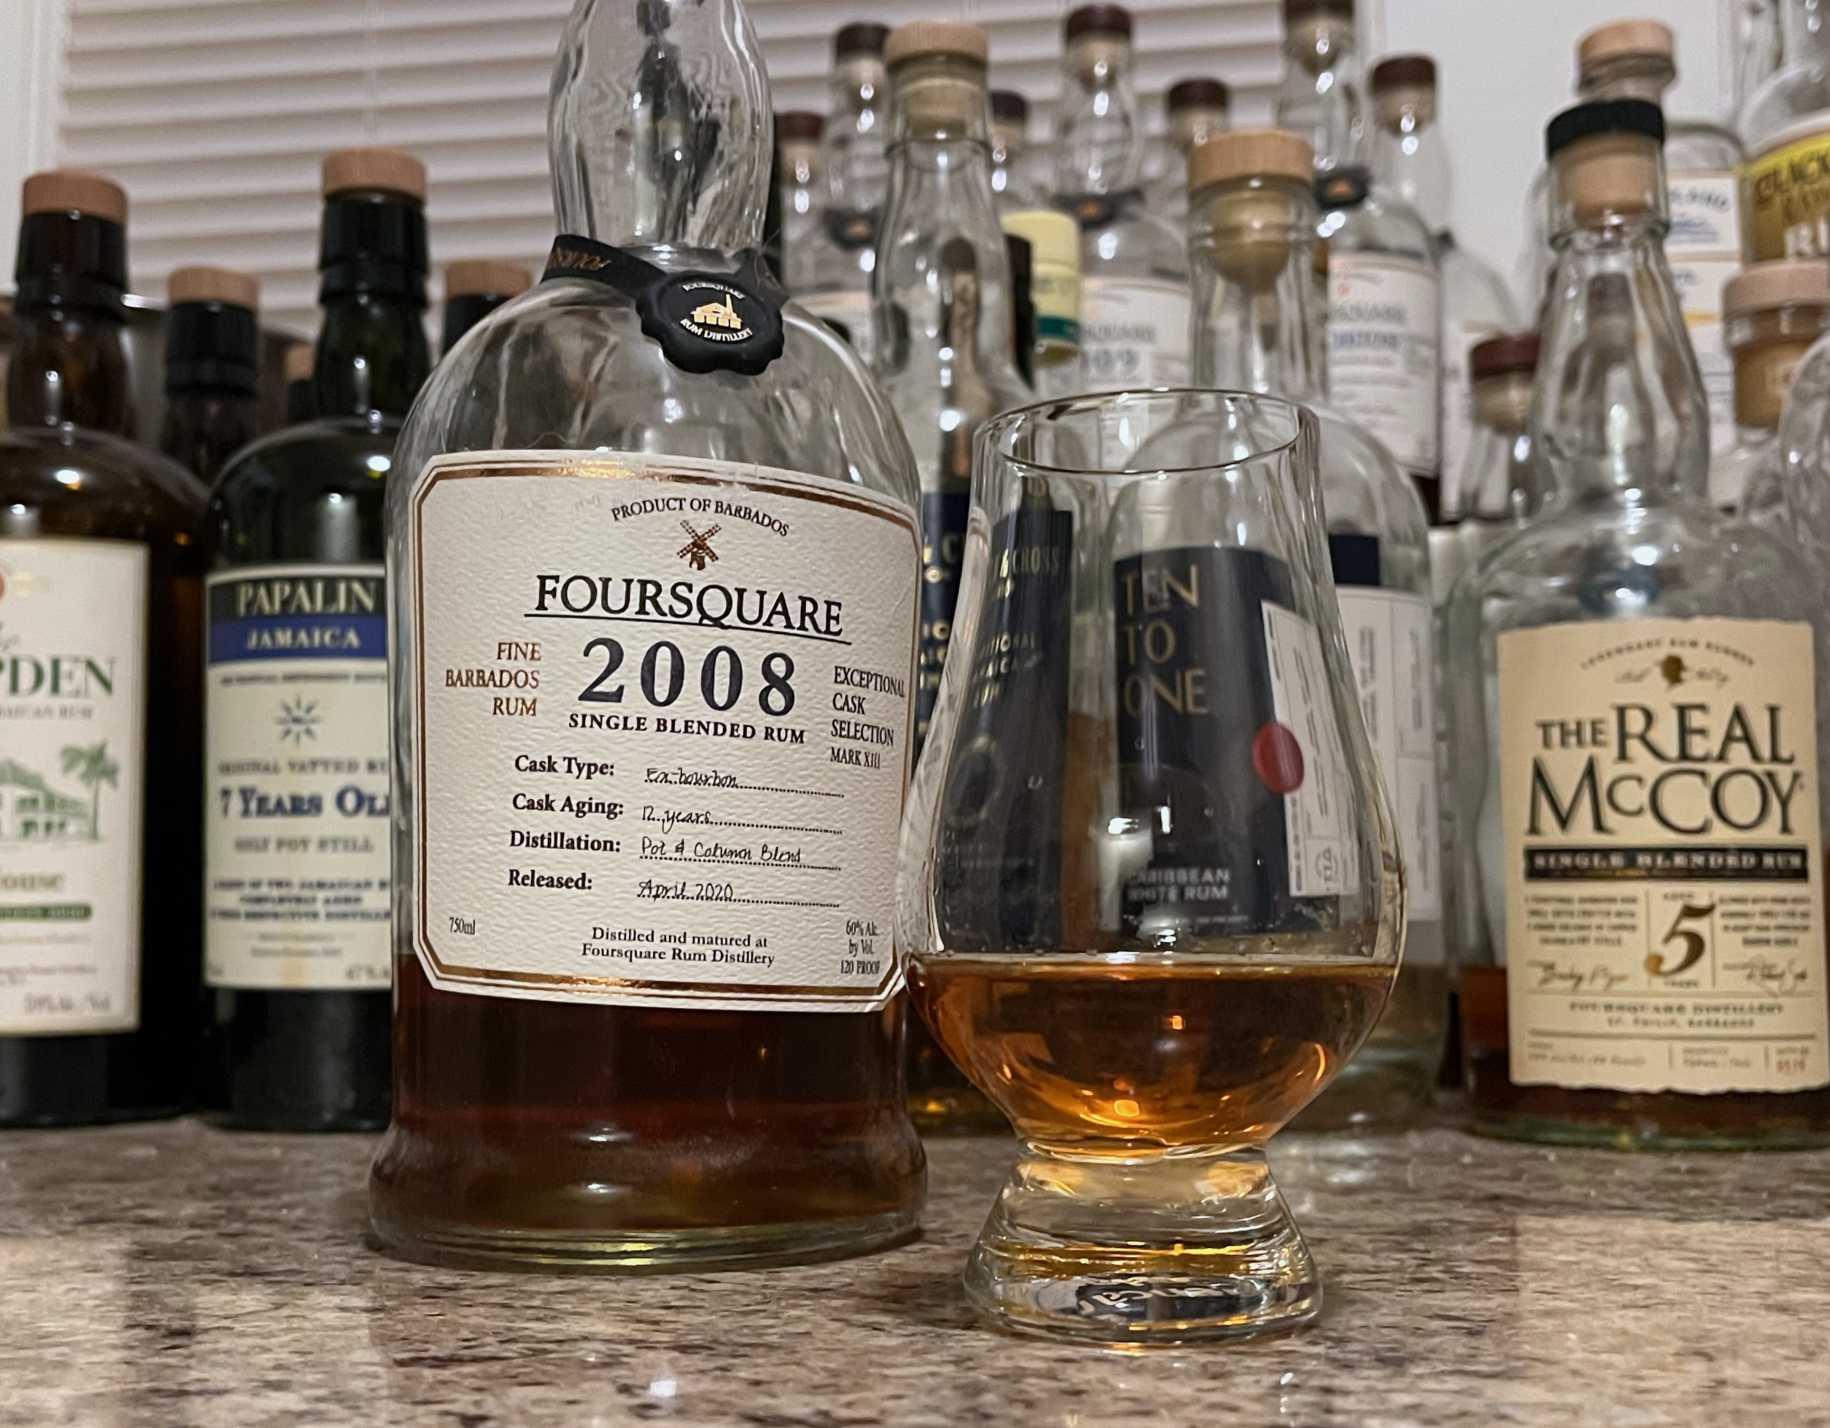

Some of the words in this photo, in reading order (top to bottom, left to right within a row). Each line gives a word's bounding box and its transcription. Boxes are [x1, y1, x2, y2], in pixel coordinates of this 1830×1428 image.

[680, 318, 703, 336] RUM
[703, 326, 753, 342] DISTILLERY
[611, 497, 686, 521] PRODUCT
[690, 498, 711, 512] OF
[715, 500, 790, 537] BARBADOS
[238, 580, 376, 616] PAPALIN
[1121, 564, 1199, 616] TEN
[534, 574, 843, 637] FOURSQUARE
[247, 626, 361, 650] JAMAICA
[497, 641, 542, 661] FINE
[1123, 620, 1176, 666] TO
[0, 654, 118, 698] DEN
[445, 668, 540, 689] BARBADOS
[577, 636, 796, 717] 2008
[834, 665, 905, 698] EXCEPTIONAL
[492, 697, 537, 717] RUM
[833, 692, 866, 715] CASK
[1124, 668, 1209, 720] ONE
[568, 713, 647, 731] SINGLE
[655, 717, 756, 740] BLENDED
[763, 726, 805, 744] RUM
[831, 719, 894, 747] SELECTION
[1535, 719, 1609, 750] THE
[1611, 703, 1795, 764] REAL
[514, 754, 559, 773] Cask
[563, 756, 615, 781] Type:
[830, 746, 862, 767] MARK
[864, 752, 881, 769] XIII
[221, 787, 232, 817] 7
[512, 792, 556, 812] Cask
[560, 795, 624, 820] Aging:
[642, 805, 655, 822] 12
[510, 829, 621, 852] Distillation:
[642, 836, 666, 856] Pot
[694, 841, 752, 860] Column
[760, 843, 801, 863] Blend
[508, 868, 593, 890] Released:
[1128, 868, 1231, 884] ARIBBEAN
[638, 880, 687, 903] April
[695, 883, 734, 900] 2020
[1184, 885, 1229, 900] RUM
[449, 916, 476, 936] 750ml
[591, 926, 655, 943] Distilled
[660, 932, 687, 944] and
[691, 934, 751, 947] matured
[755, 936, 768, 948] at
[849, 938, 858, 957] by
[1645, 903, 1716, 977] 5
[581, 942, 666, 962] Foursquare
[671, 947, 707, 962] Rum
[711, 949, 775, 968] Distillery
[841, 960, 854, 974] 120
[857, 960, 880, 975] PROOF
